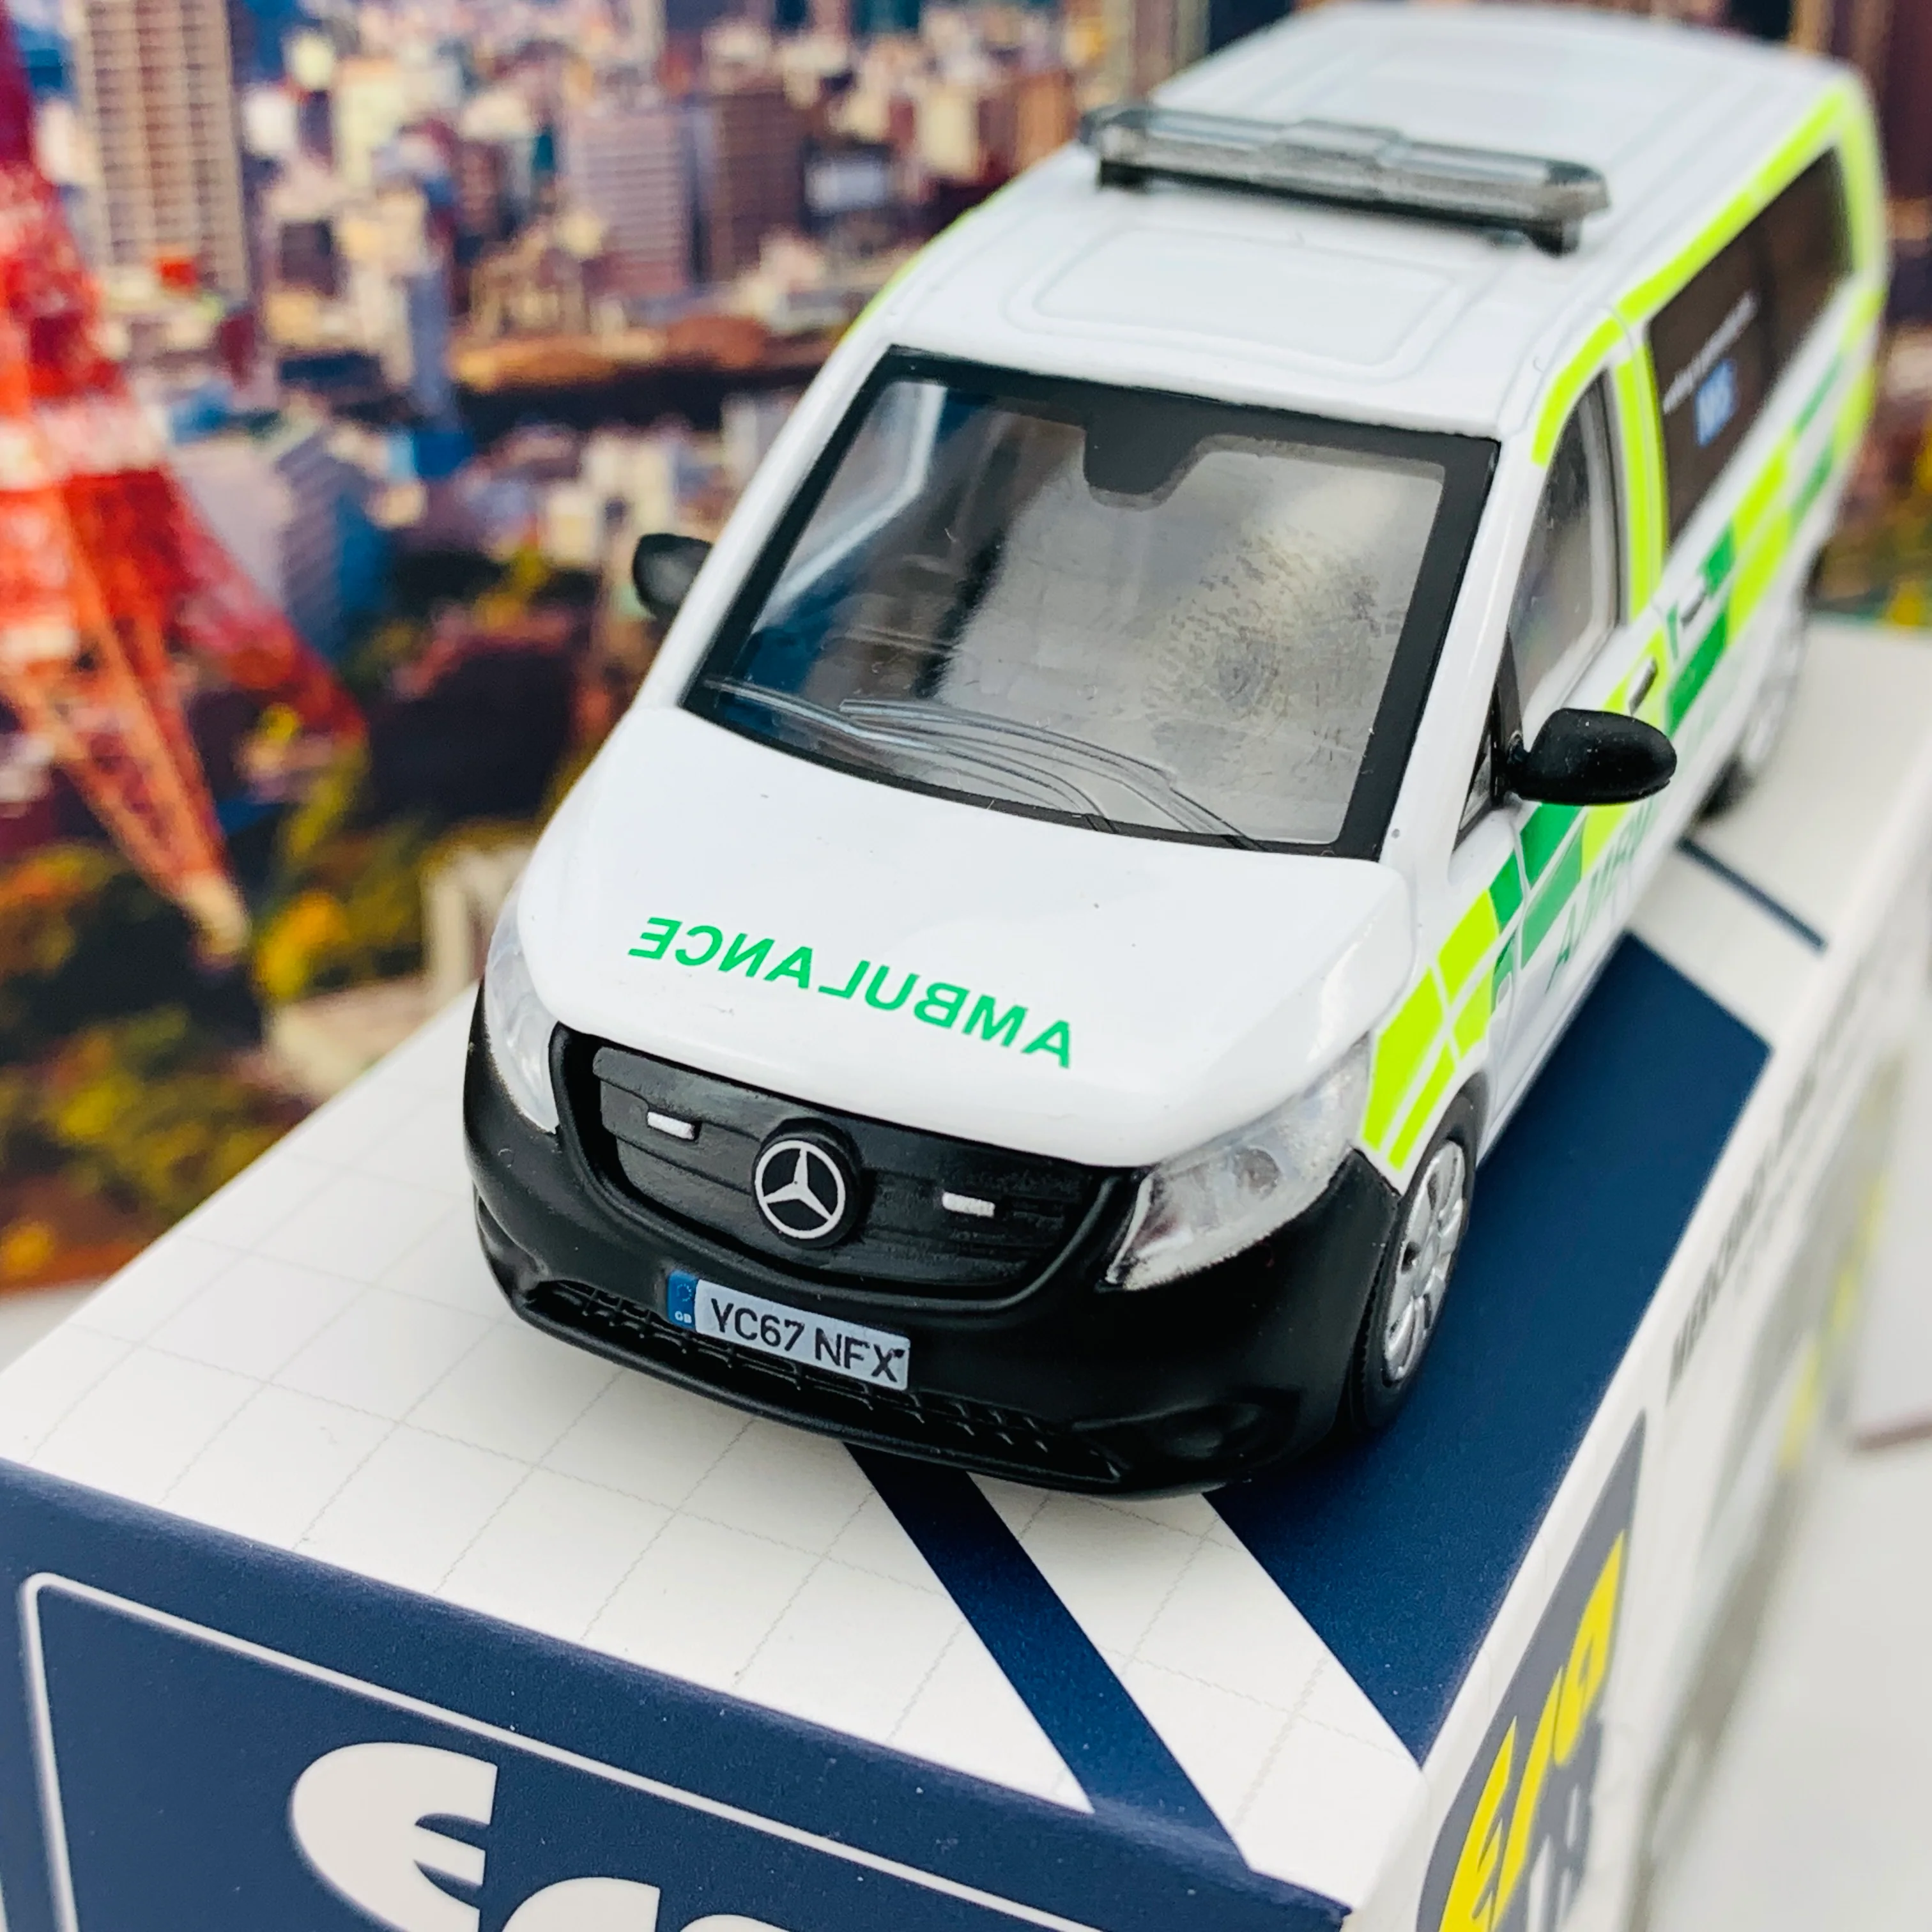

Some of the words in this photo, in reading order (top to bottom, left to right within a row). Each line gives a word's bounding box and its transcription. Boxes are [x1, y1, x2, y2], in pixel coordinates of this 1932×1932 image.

[675, 1310, 692, 1324] GB
[710, 1298, 805, 1352] YC67
[815, 1327, 902, 1383] NFX
